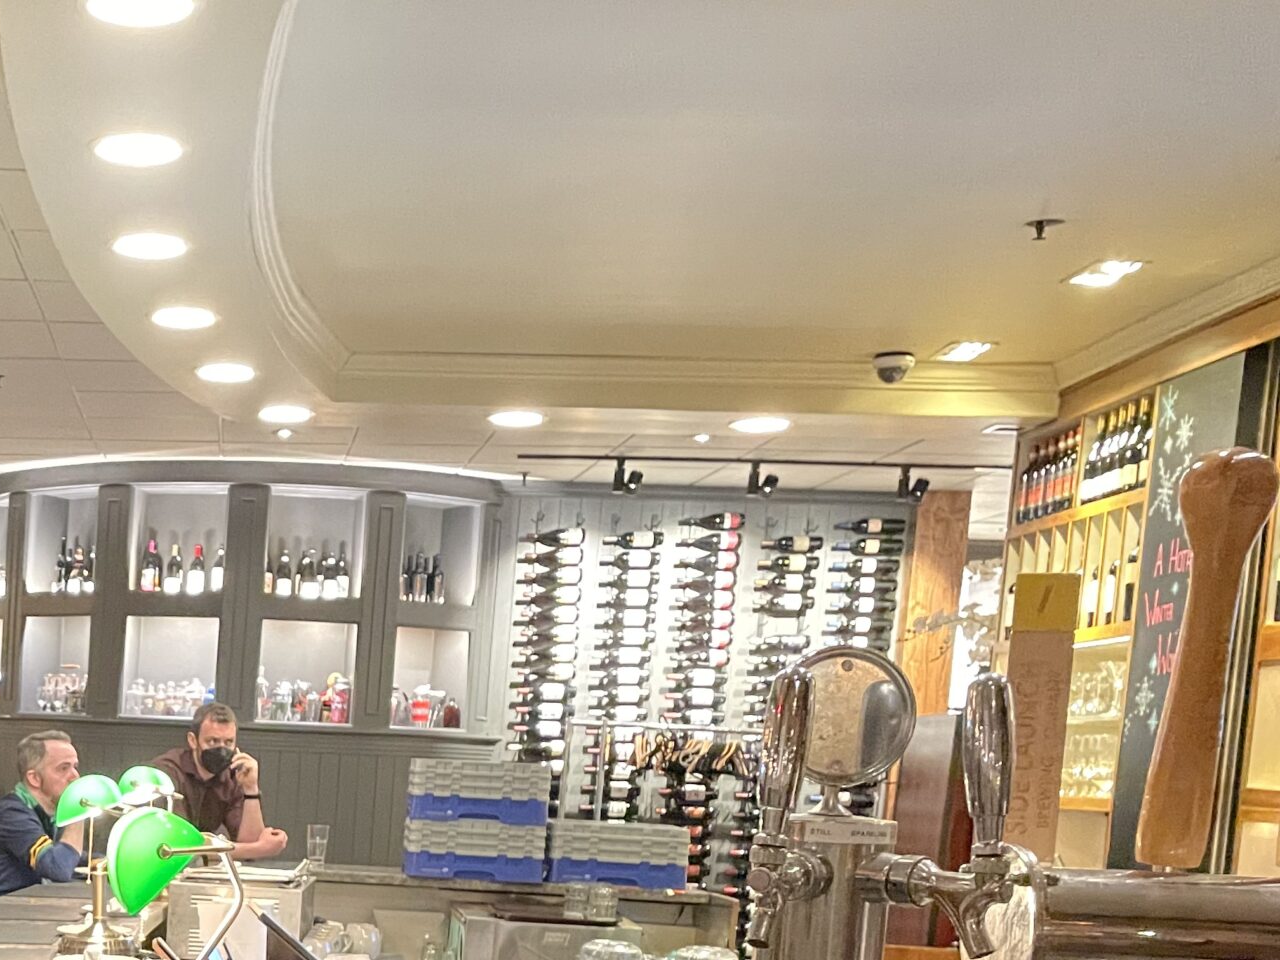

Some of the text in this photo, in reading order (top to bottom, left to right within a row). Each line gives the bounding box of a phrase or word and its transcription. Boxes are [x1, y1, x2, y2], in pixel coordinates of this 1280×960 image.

[1153, 543, 1164, 578] A
[1005, 780, 1031, 835] SIDE
[1035, 755, 1055, 829] BREWING
[810, 827, 832, 836] STILL
